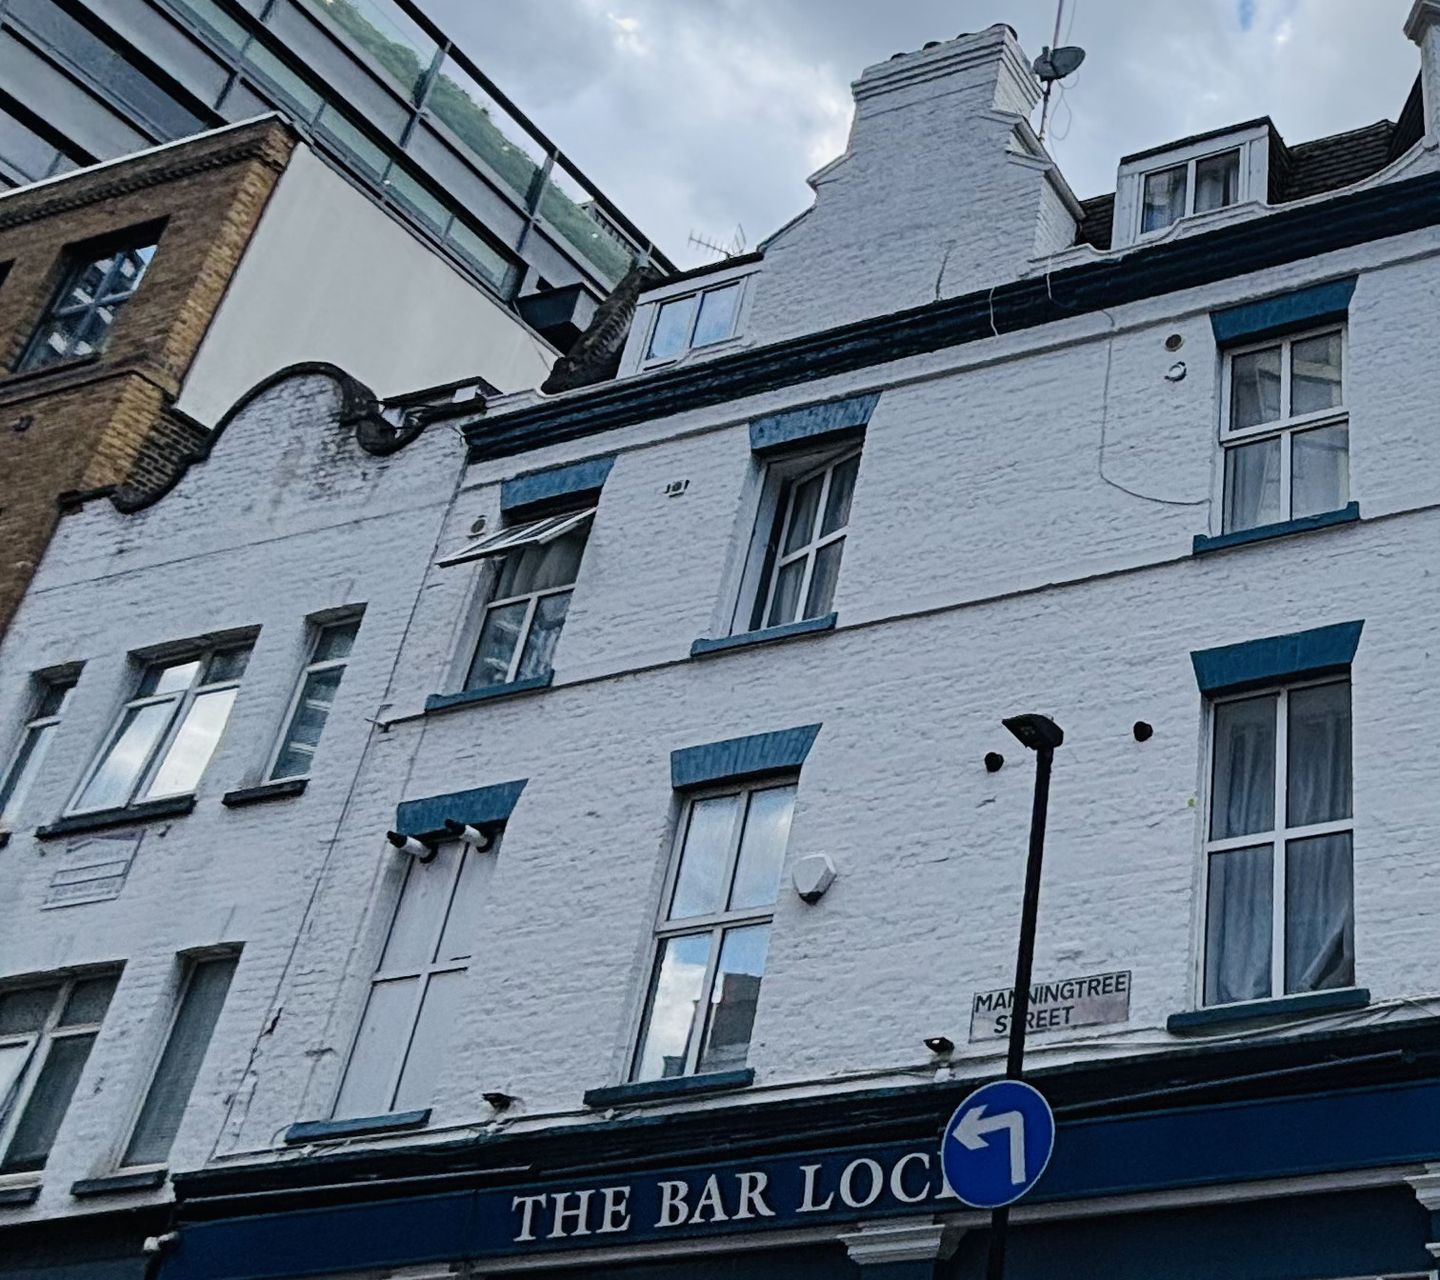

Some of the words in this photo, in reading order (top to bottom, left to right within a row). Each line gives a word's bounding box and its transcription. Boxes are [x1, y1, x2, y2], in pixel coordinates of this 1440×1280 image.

[994, 1006, 1075, 1034] SREET
[512, 1185, 631, 1242] THE
[654, 1171, 776, 1229] BAR
